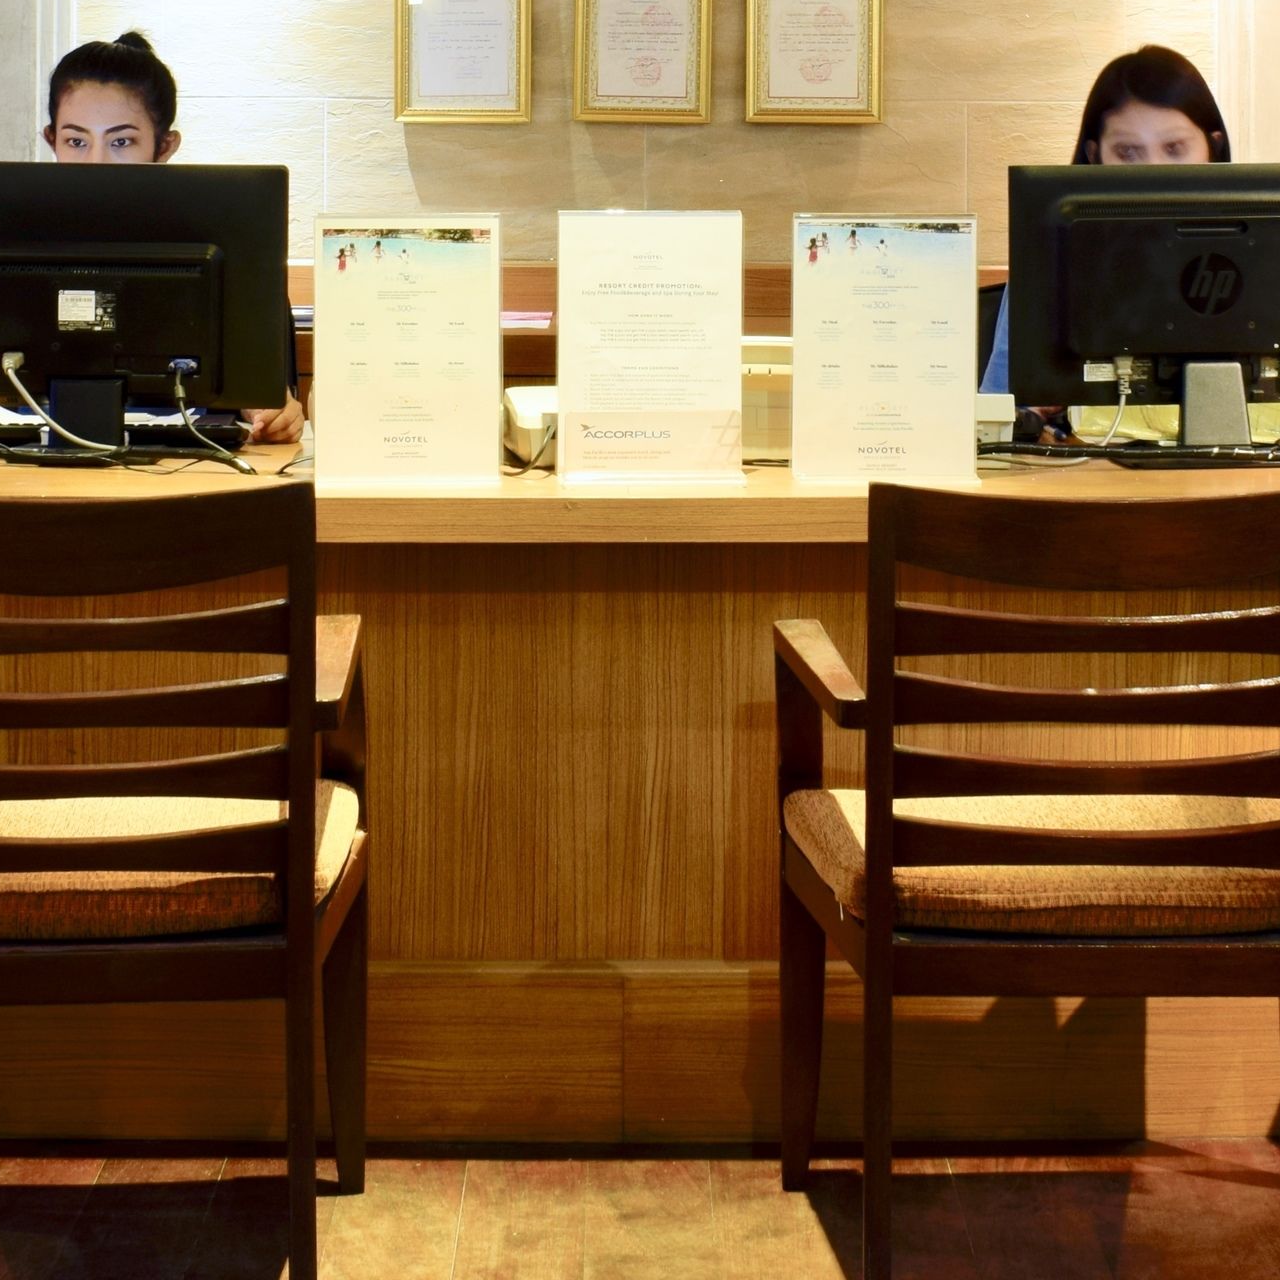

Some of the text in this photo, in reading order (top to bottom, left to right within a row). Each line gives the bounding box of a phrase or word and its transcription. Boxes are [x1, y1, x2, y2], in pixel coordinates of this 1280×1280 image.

[598, 282, 627, 290] RESORT
[628, 282, 654, 290] CREDIT
[1187, 254, 1237, 317] hp
[583, 430, 671, 439] ACCORPLUS
[857, 446, 907, 454] NOVOTEL
